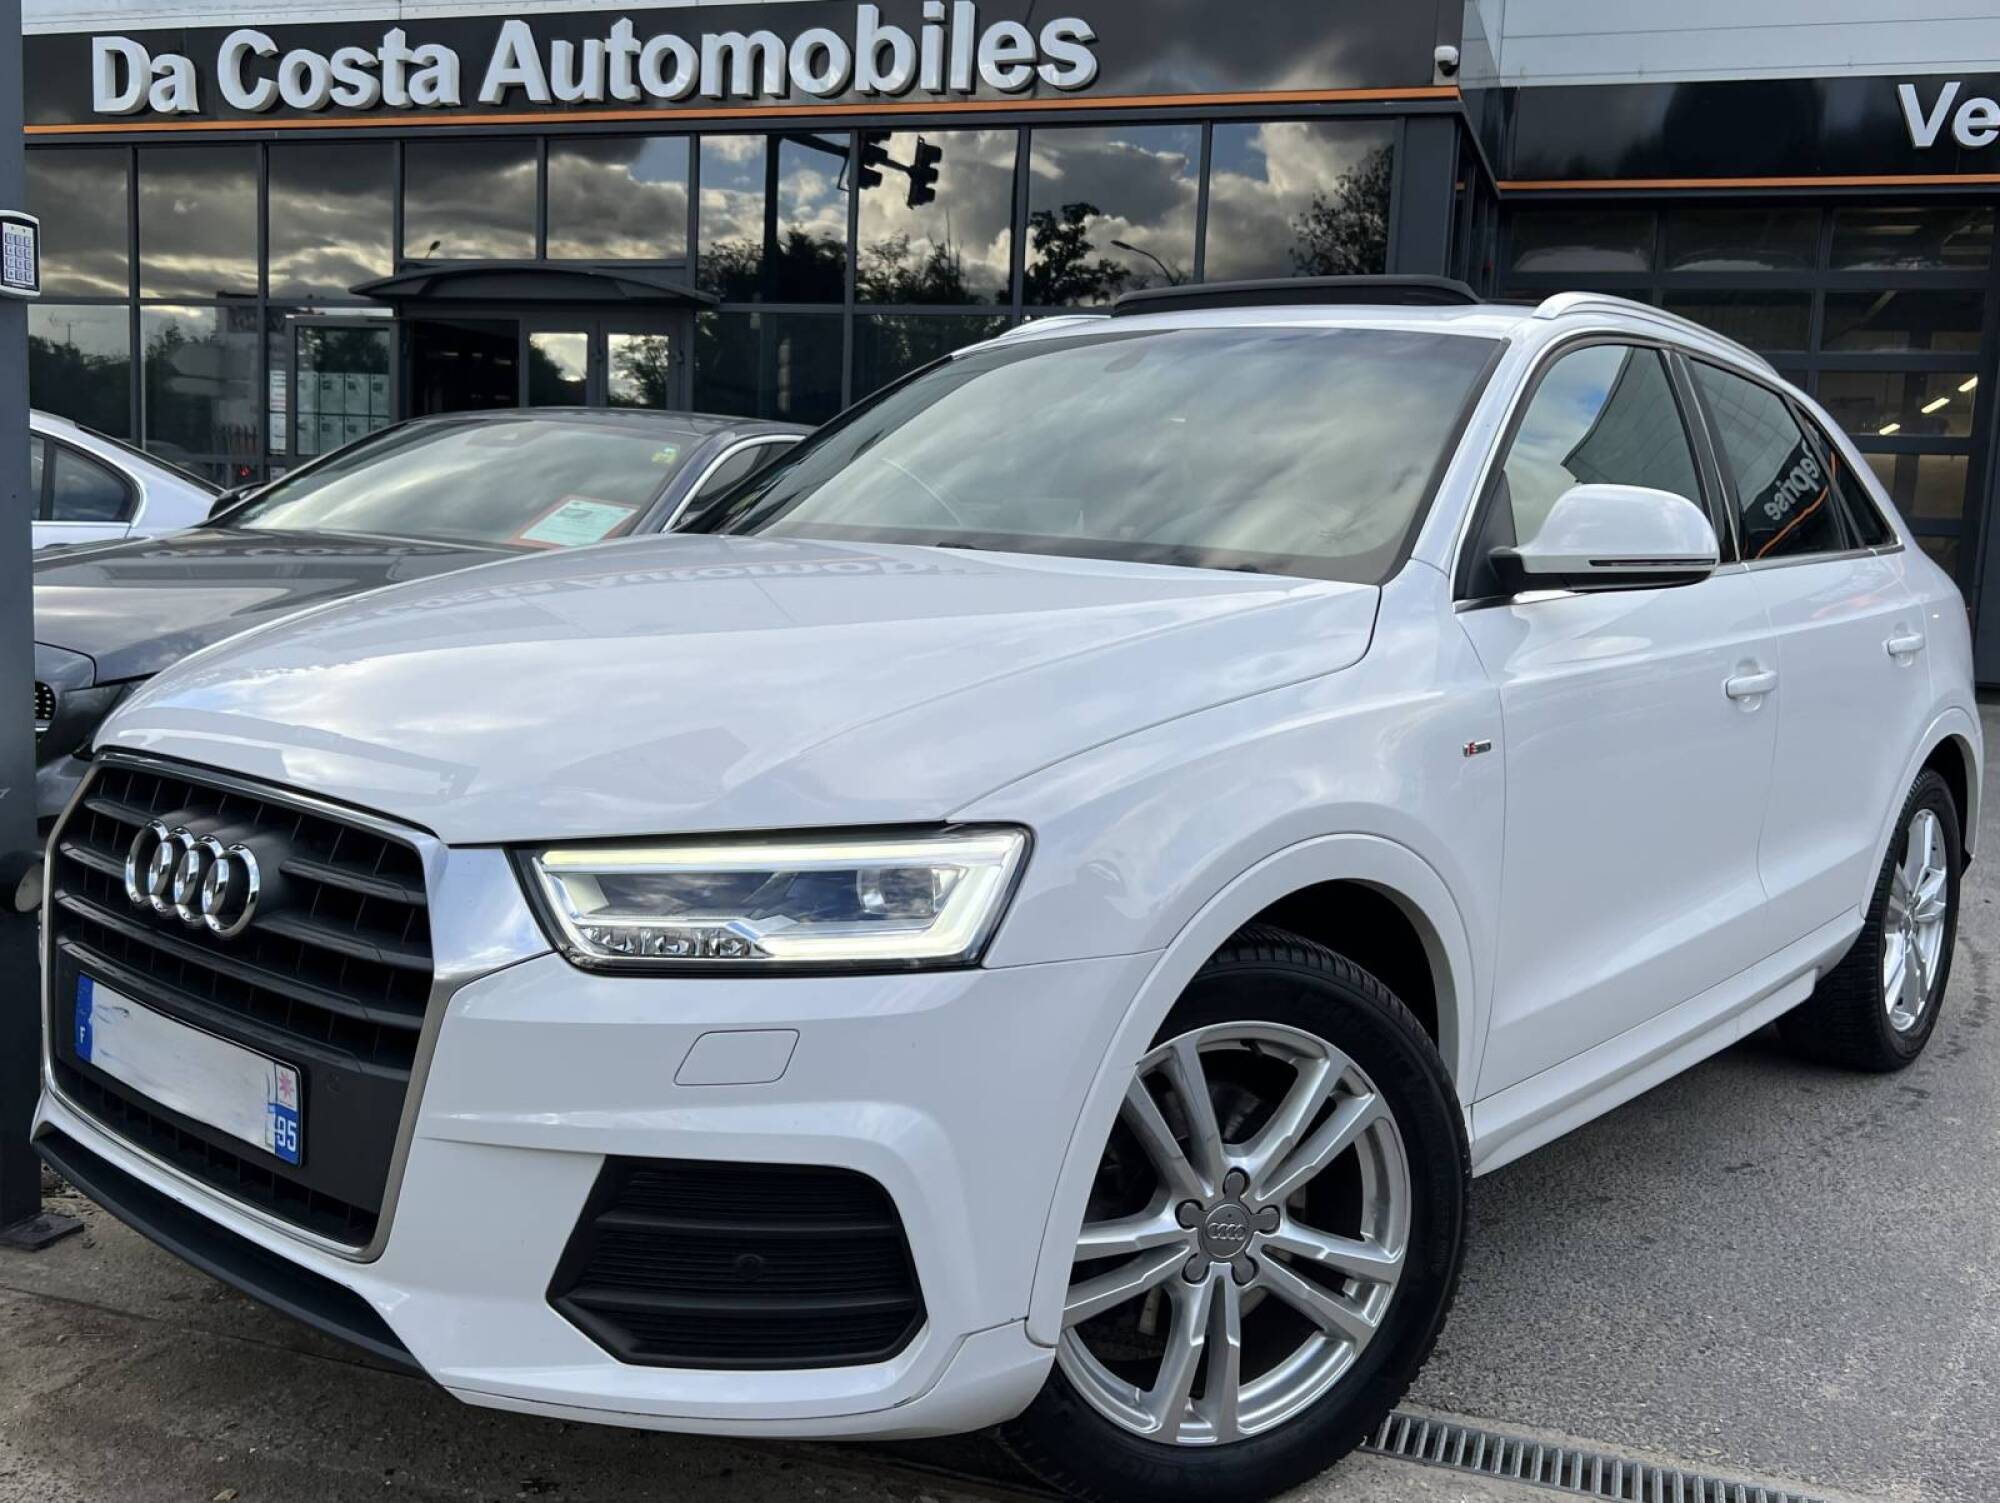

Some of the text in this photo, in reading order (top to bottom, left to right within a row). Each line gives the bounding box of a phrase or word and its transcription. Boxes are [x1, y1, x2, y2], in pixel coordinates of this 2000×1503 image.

[91, 0, 1099, 115] Da Costa Automobiles
[1896, 81, 2000, 149] Ve
[79, 1026, 86, 1044] F
[275, 1116, 297, 1151] 95
